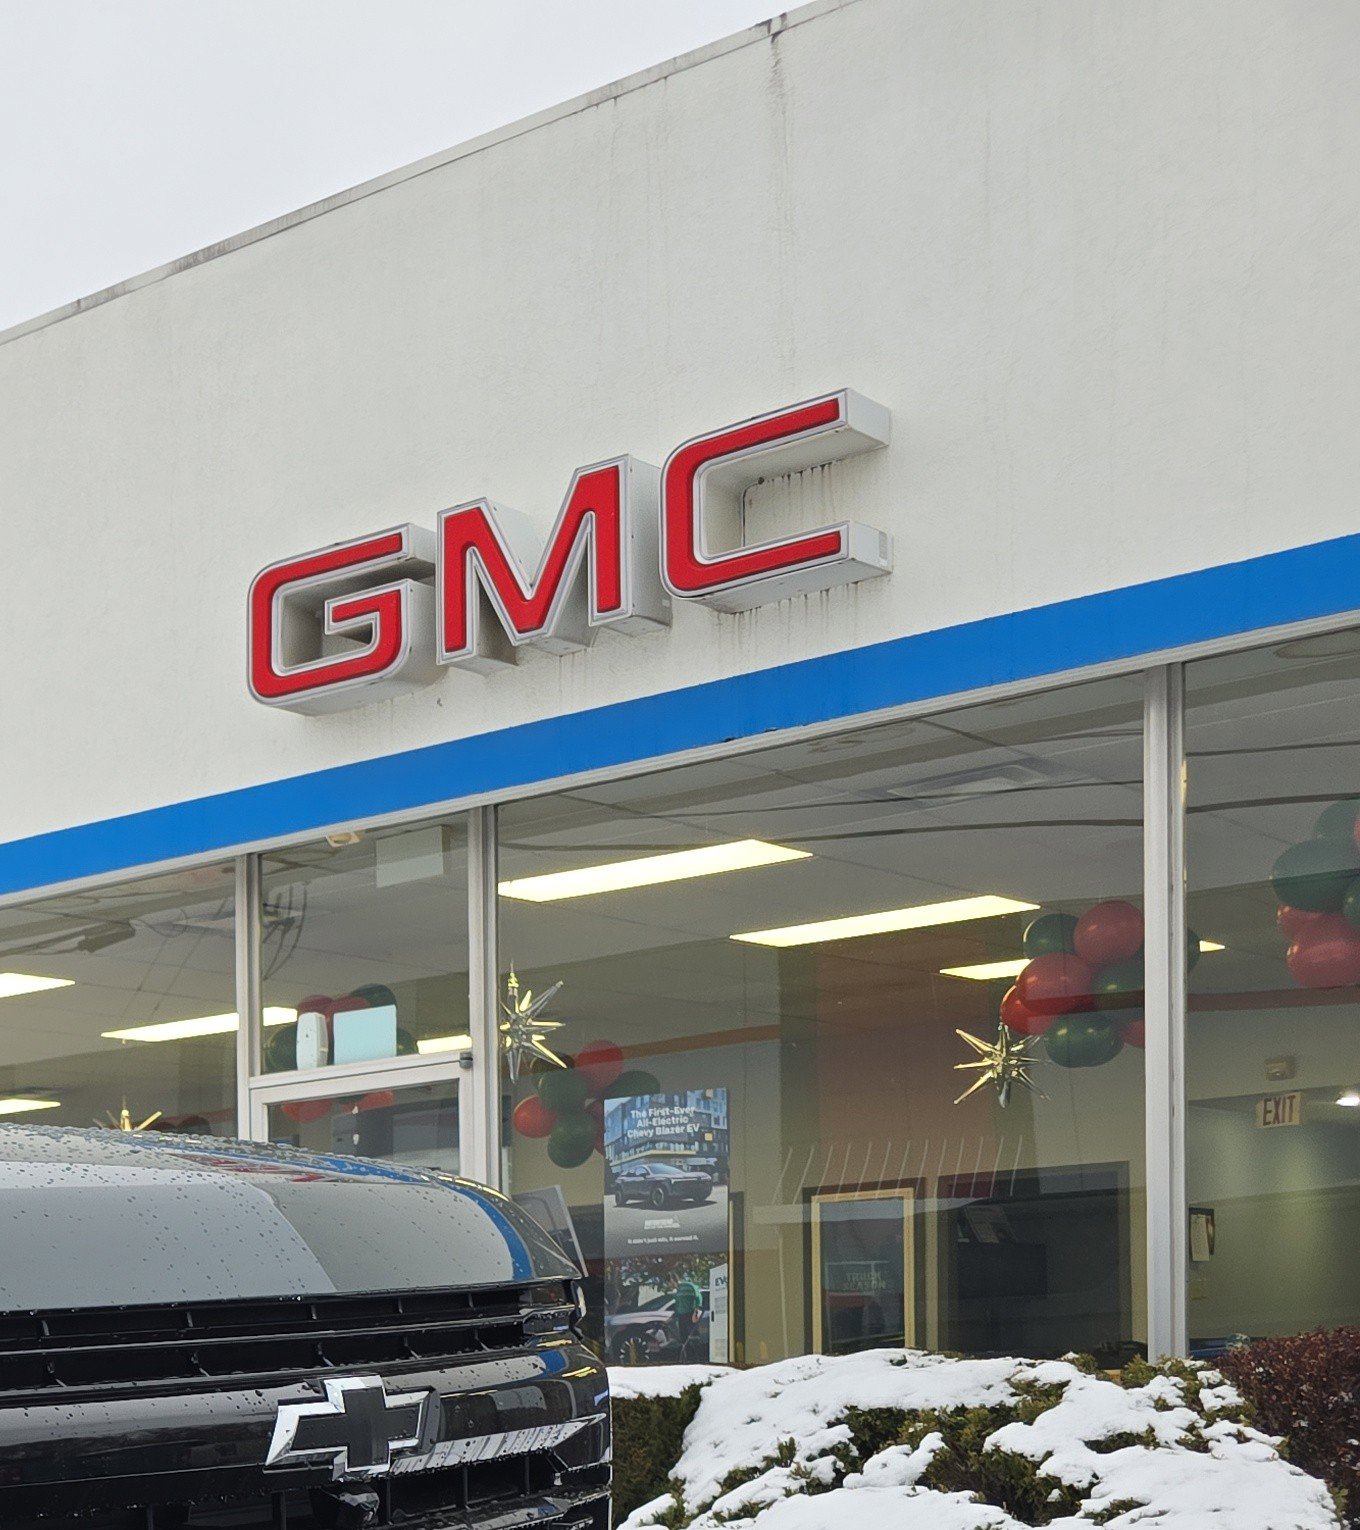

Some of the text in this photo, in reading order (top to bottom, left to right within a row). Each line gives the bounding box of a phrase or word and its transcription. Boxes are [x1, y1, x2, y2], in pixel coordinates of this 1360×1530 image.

[247, 388, 852, 711] GMC
[630, 1109, 647, 1119] The
[1263, 1095, 1296, 1126] EXIT
[636, 1116, 689, 1128] All-Electric
[627, 1123, 700, 1138] Chevy Blazer EV
